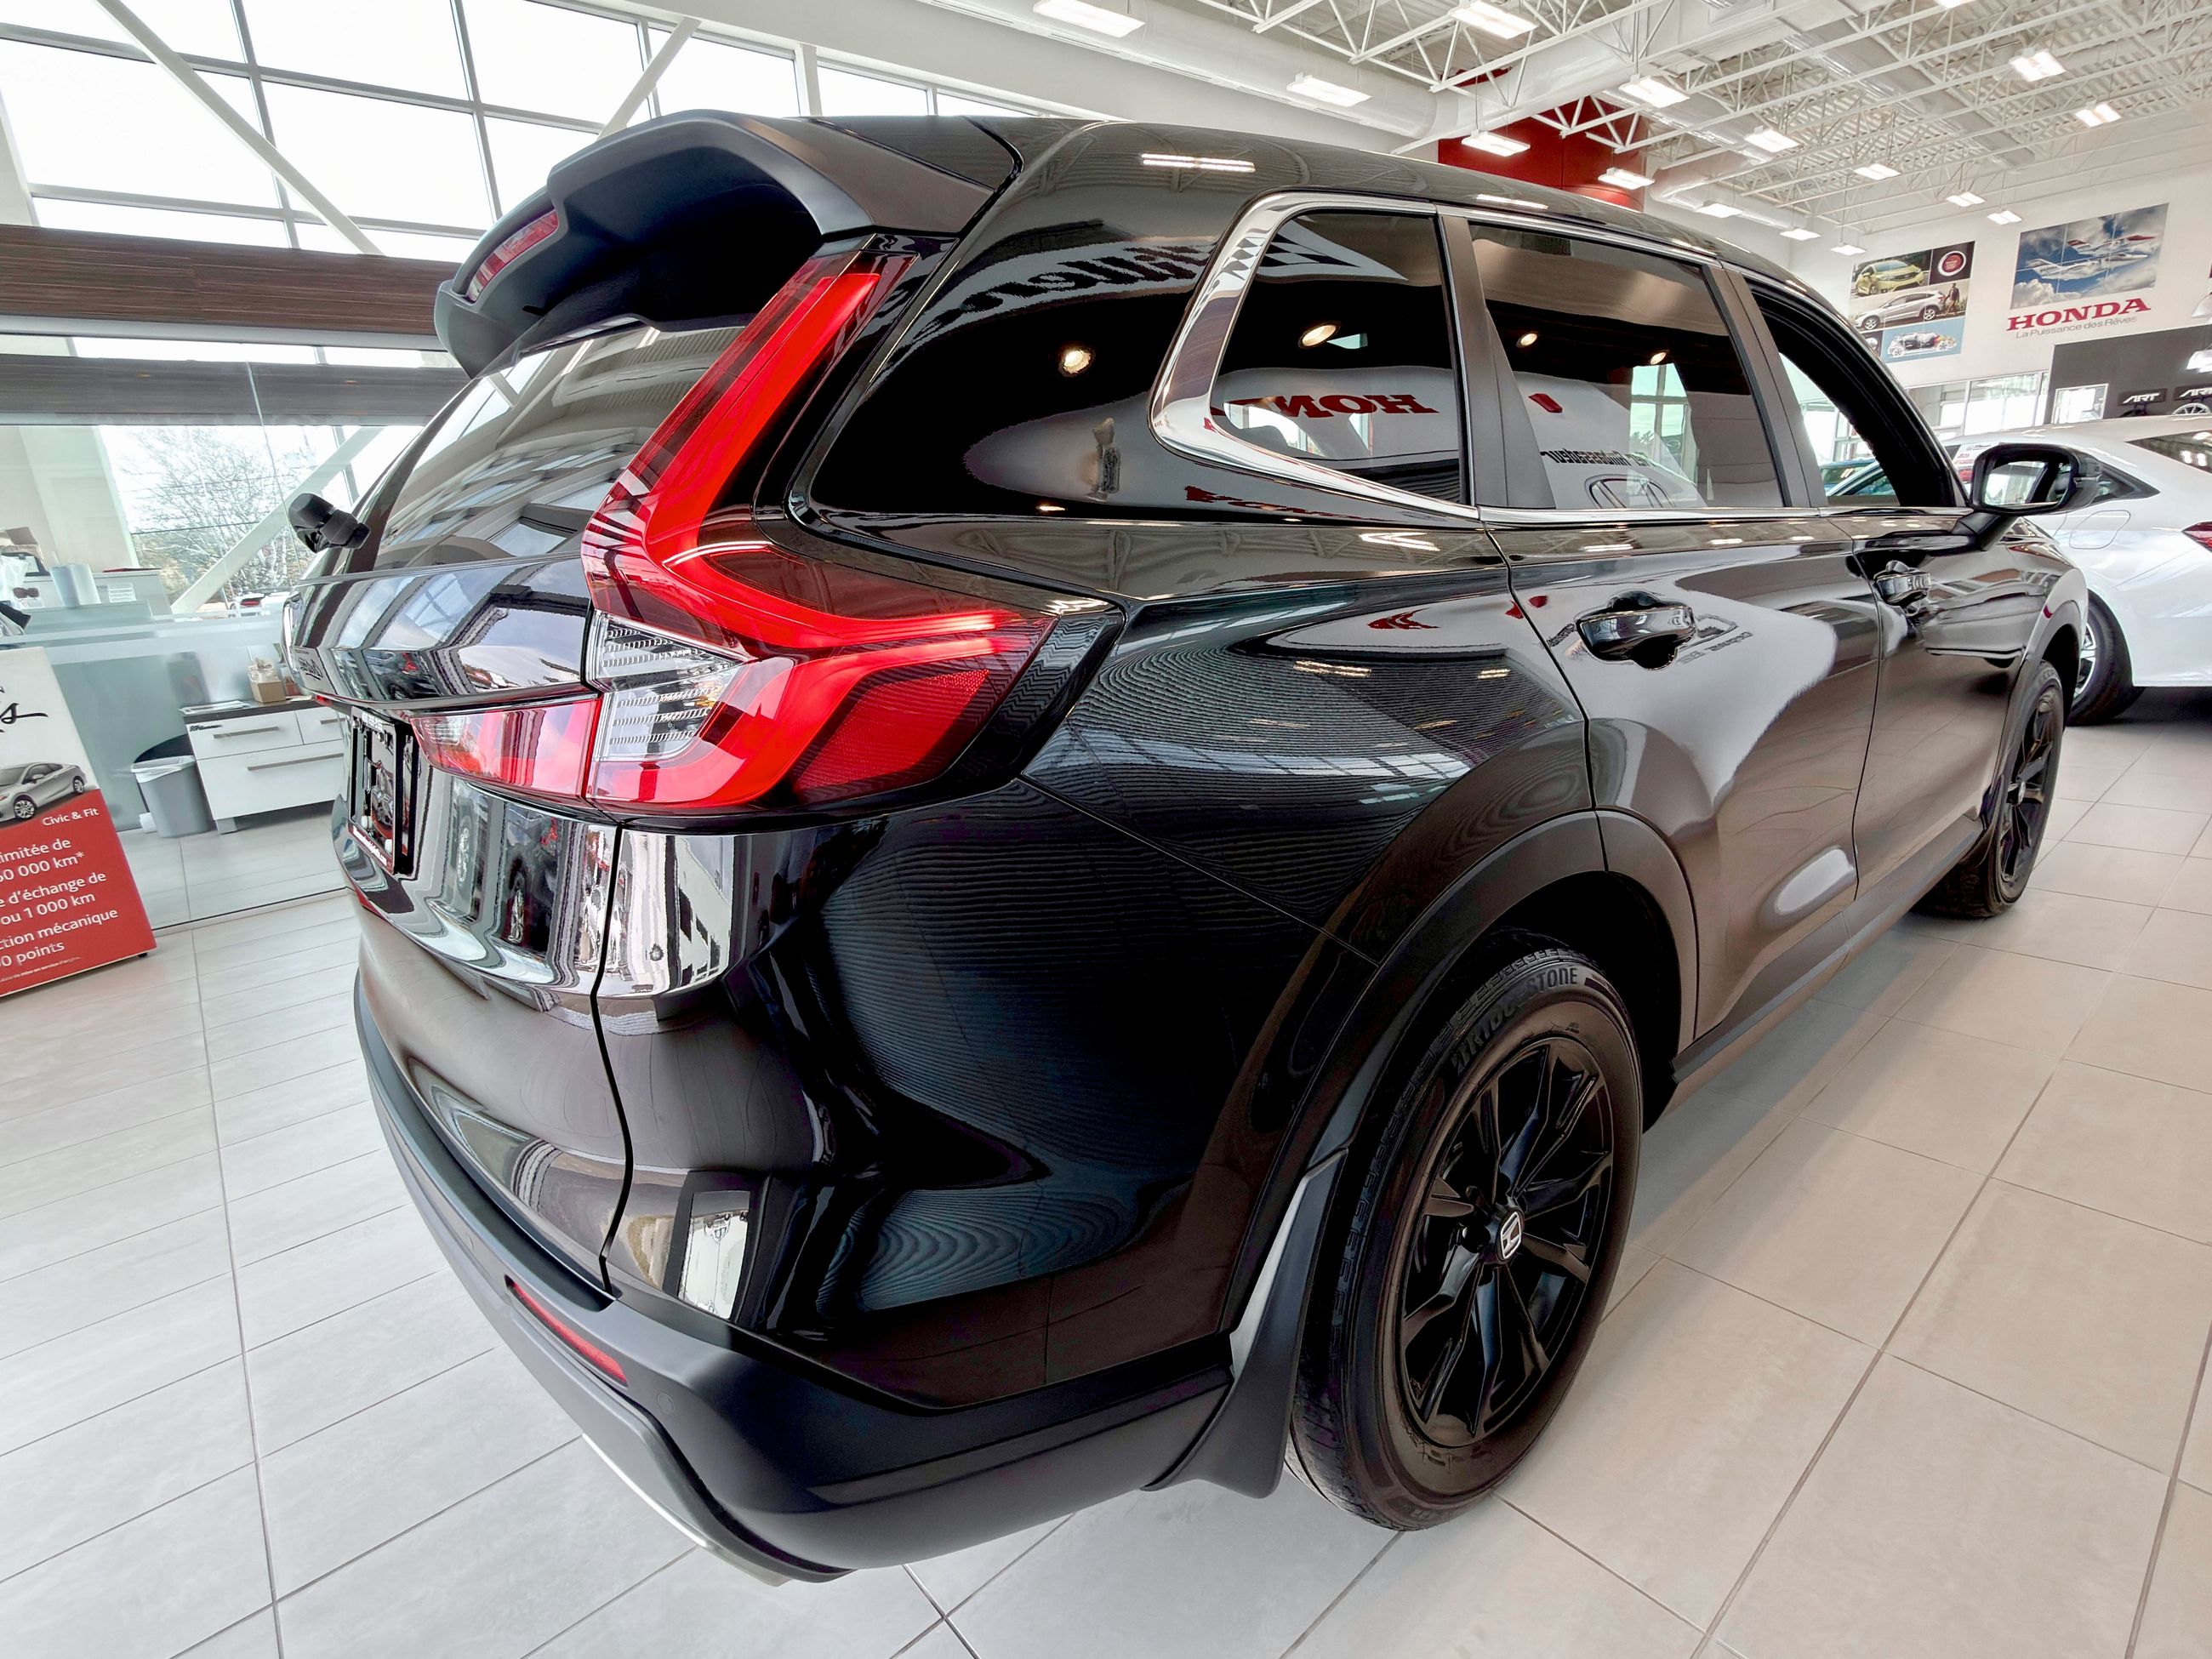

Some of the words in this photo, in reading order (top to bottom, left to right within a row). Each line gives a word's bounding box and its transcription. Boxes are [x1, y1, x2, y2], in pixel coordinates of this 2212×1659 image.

[2006, 298, 2151, 331] HONDA
[2015, 330, 2028, 339] La
[2030, 324, 2082, 337] Puissance
[2084, 320, 2104, 329] des
[2104, 316, 2138, 327] Rêves
[43, 813, 70, 826] Civic
[71, 811, 83, 820] &
[83, 807, 100, 818] Fit
[0, 843, 49, 864] imitée
[52, 838, 71, 851] de
[18, 860, 50, 877] 000
[88, 872, 107, 885] de
[1, 913, 22, 925] ou
[23, 907, 33, 918] 1
[36, 898, 68, 915] 000
[71, 893, 96, 907] km
[37, 909, 118, 938] mécanique
[16, 942, 65, 966] points
